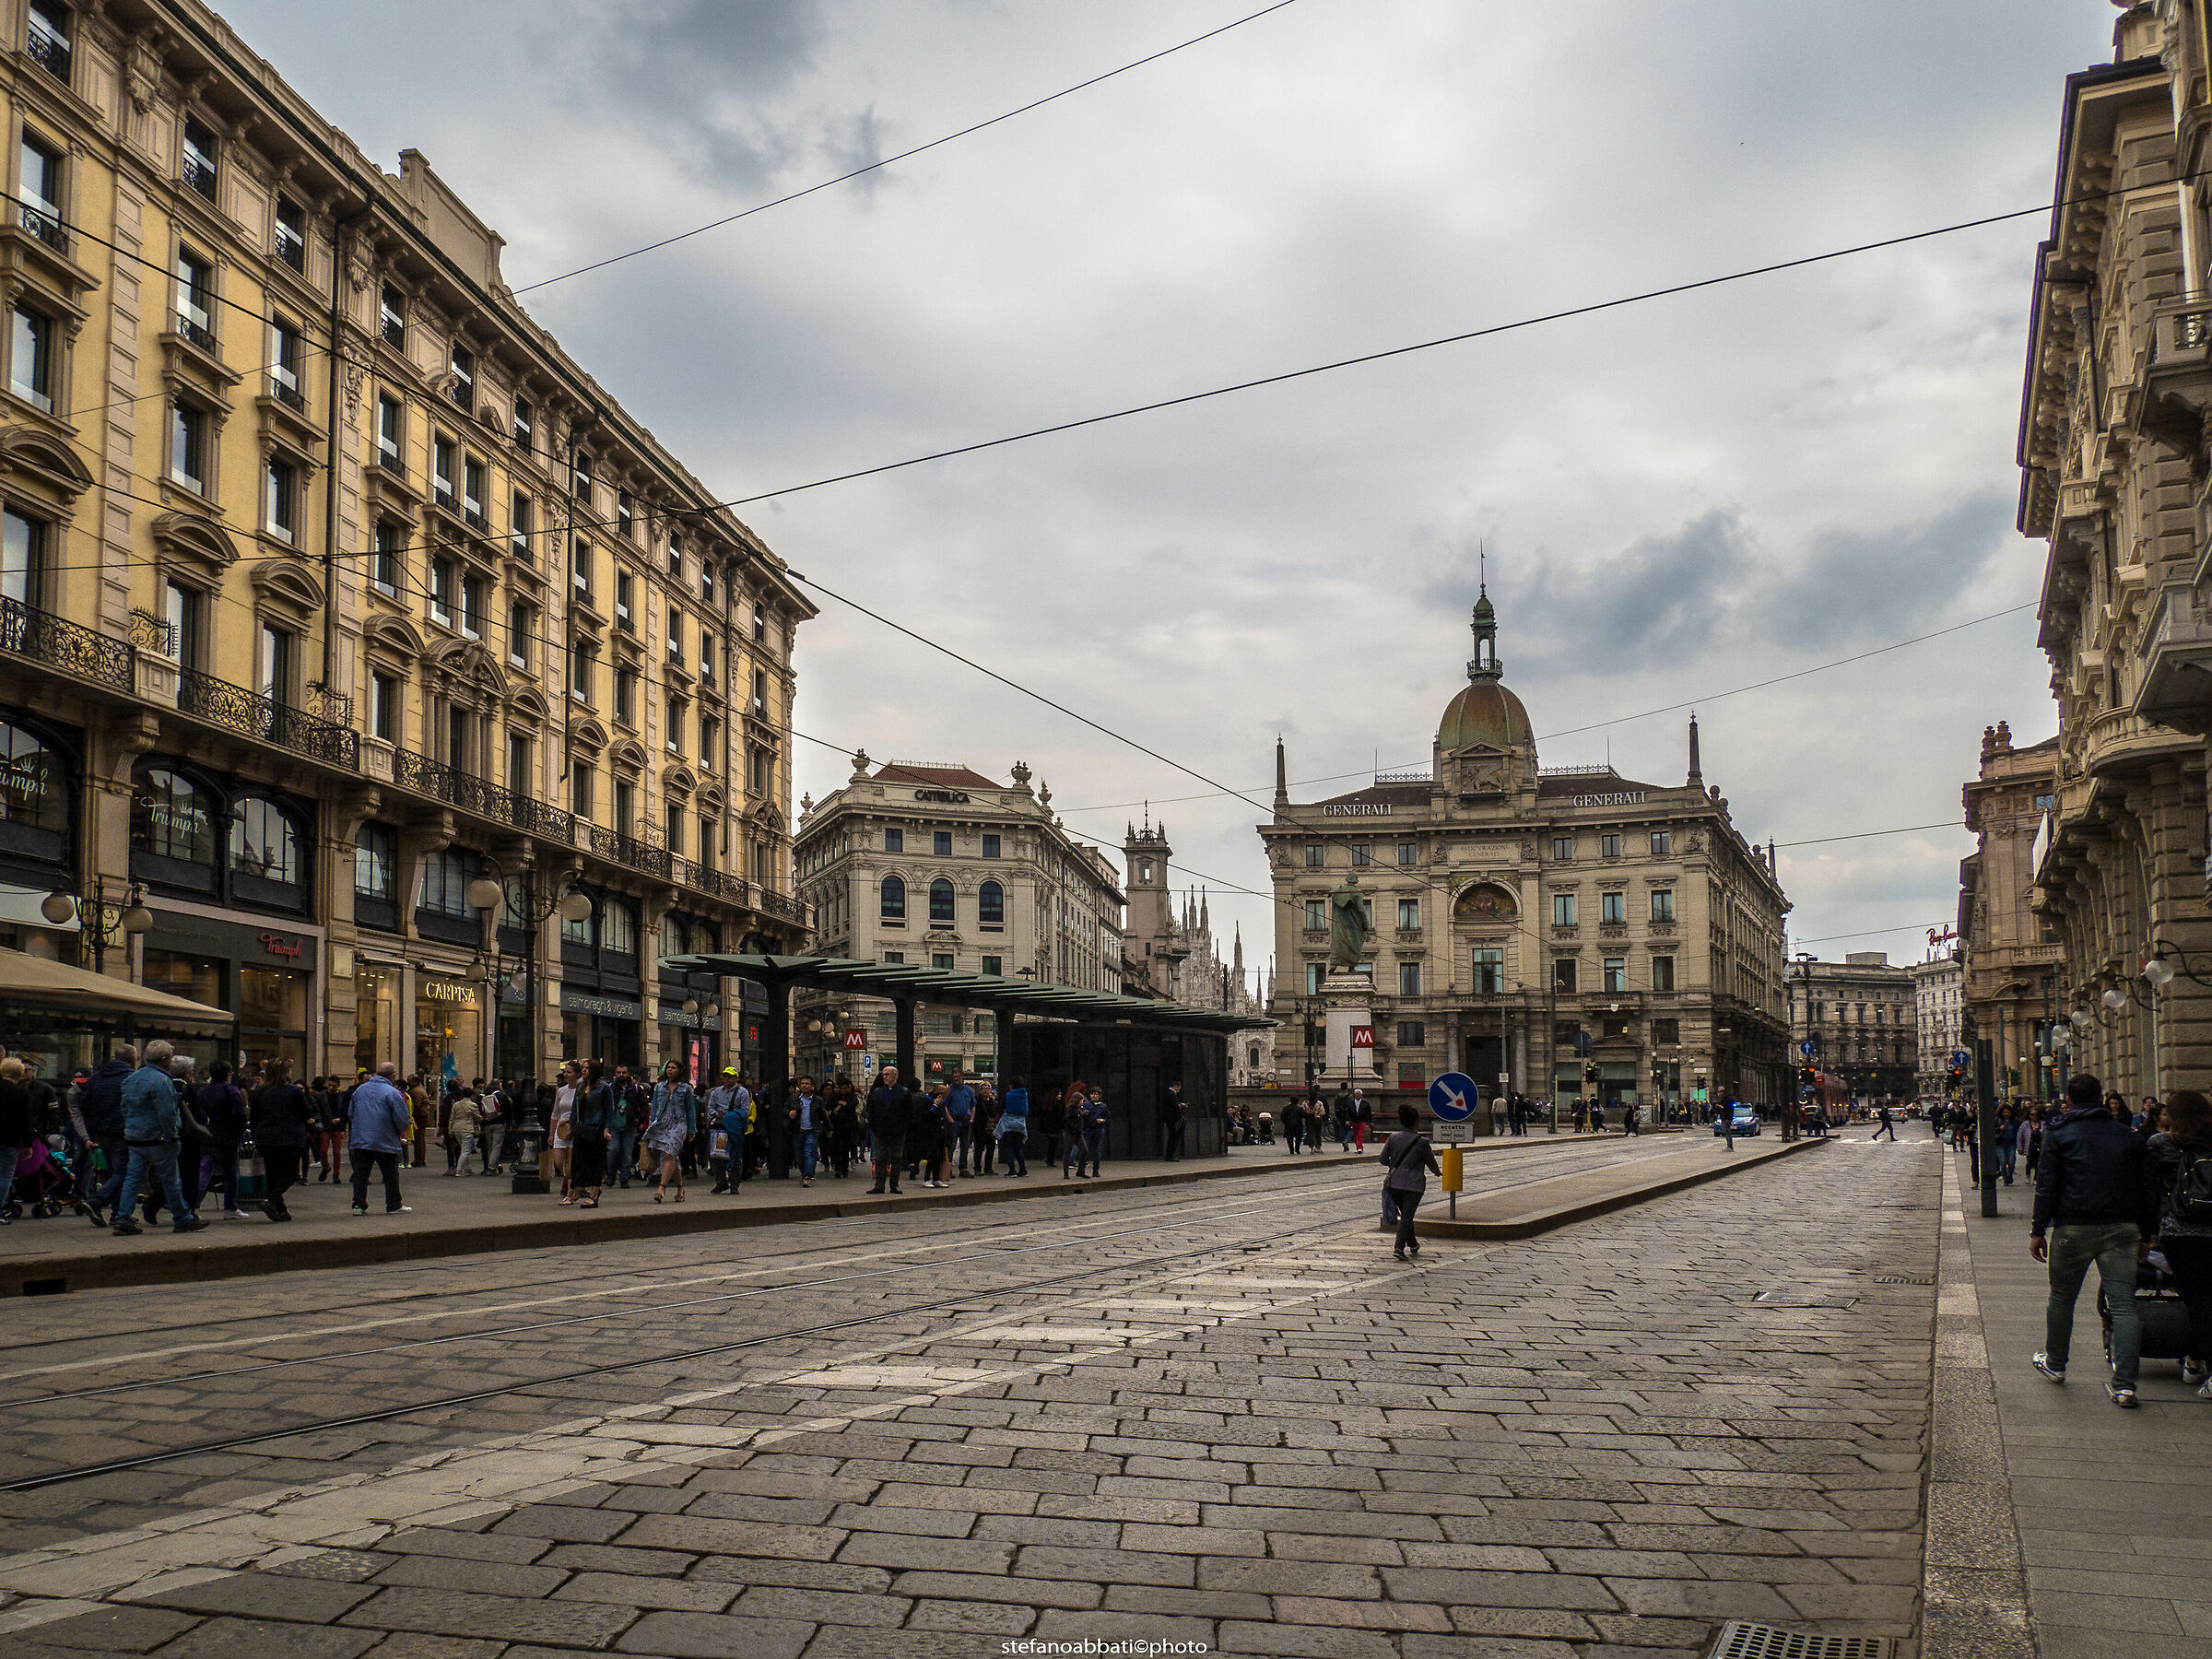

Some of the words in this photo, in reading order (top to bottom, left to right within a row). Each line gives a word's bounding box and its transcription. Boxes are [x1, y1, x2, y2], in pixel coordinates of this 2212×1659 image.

[1572, 791, 1645, 807] GENERALI
[1323, 804, 1393, 817] GENERALI
[259, 932, 303, 964] Triumph
[426, 981, 477, 1004] CARPISA
[606, 1000, 612, 1012] &
[846, 1033, 863, 1046] M
[1354, 1030, 1372, 1043] M
